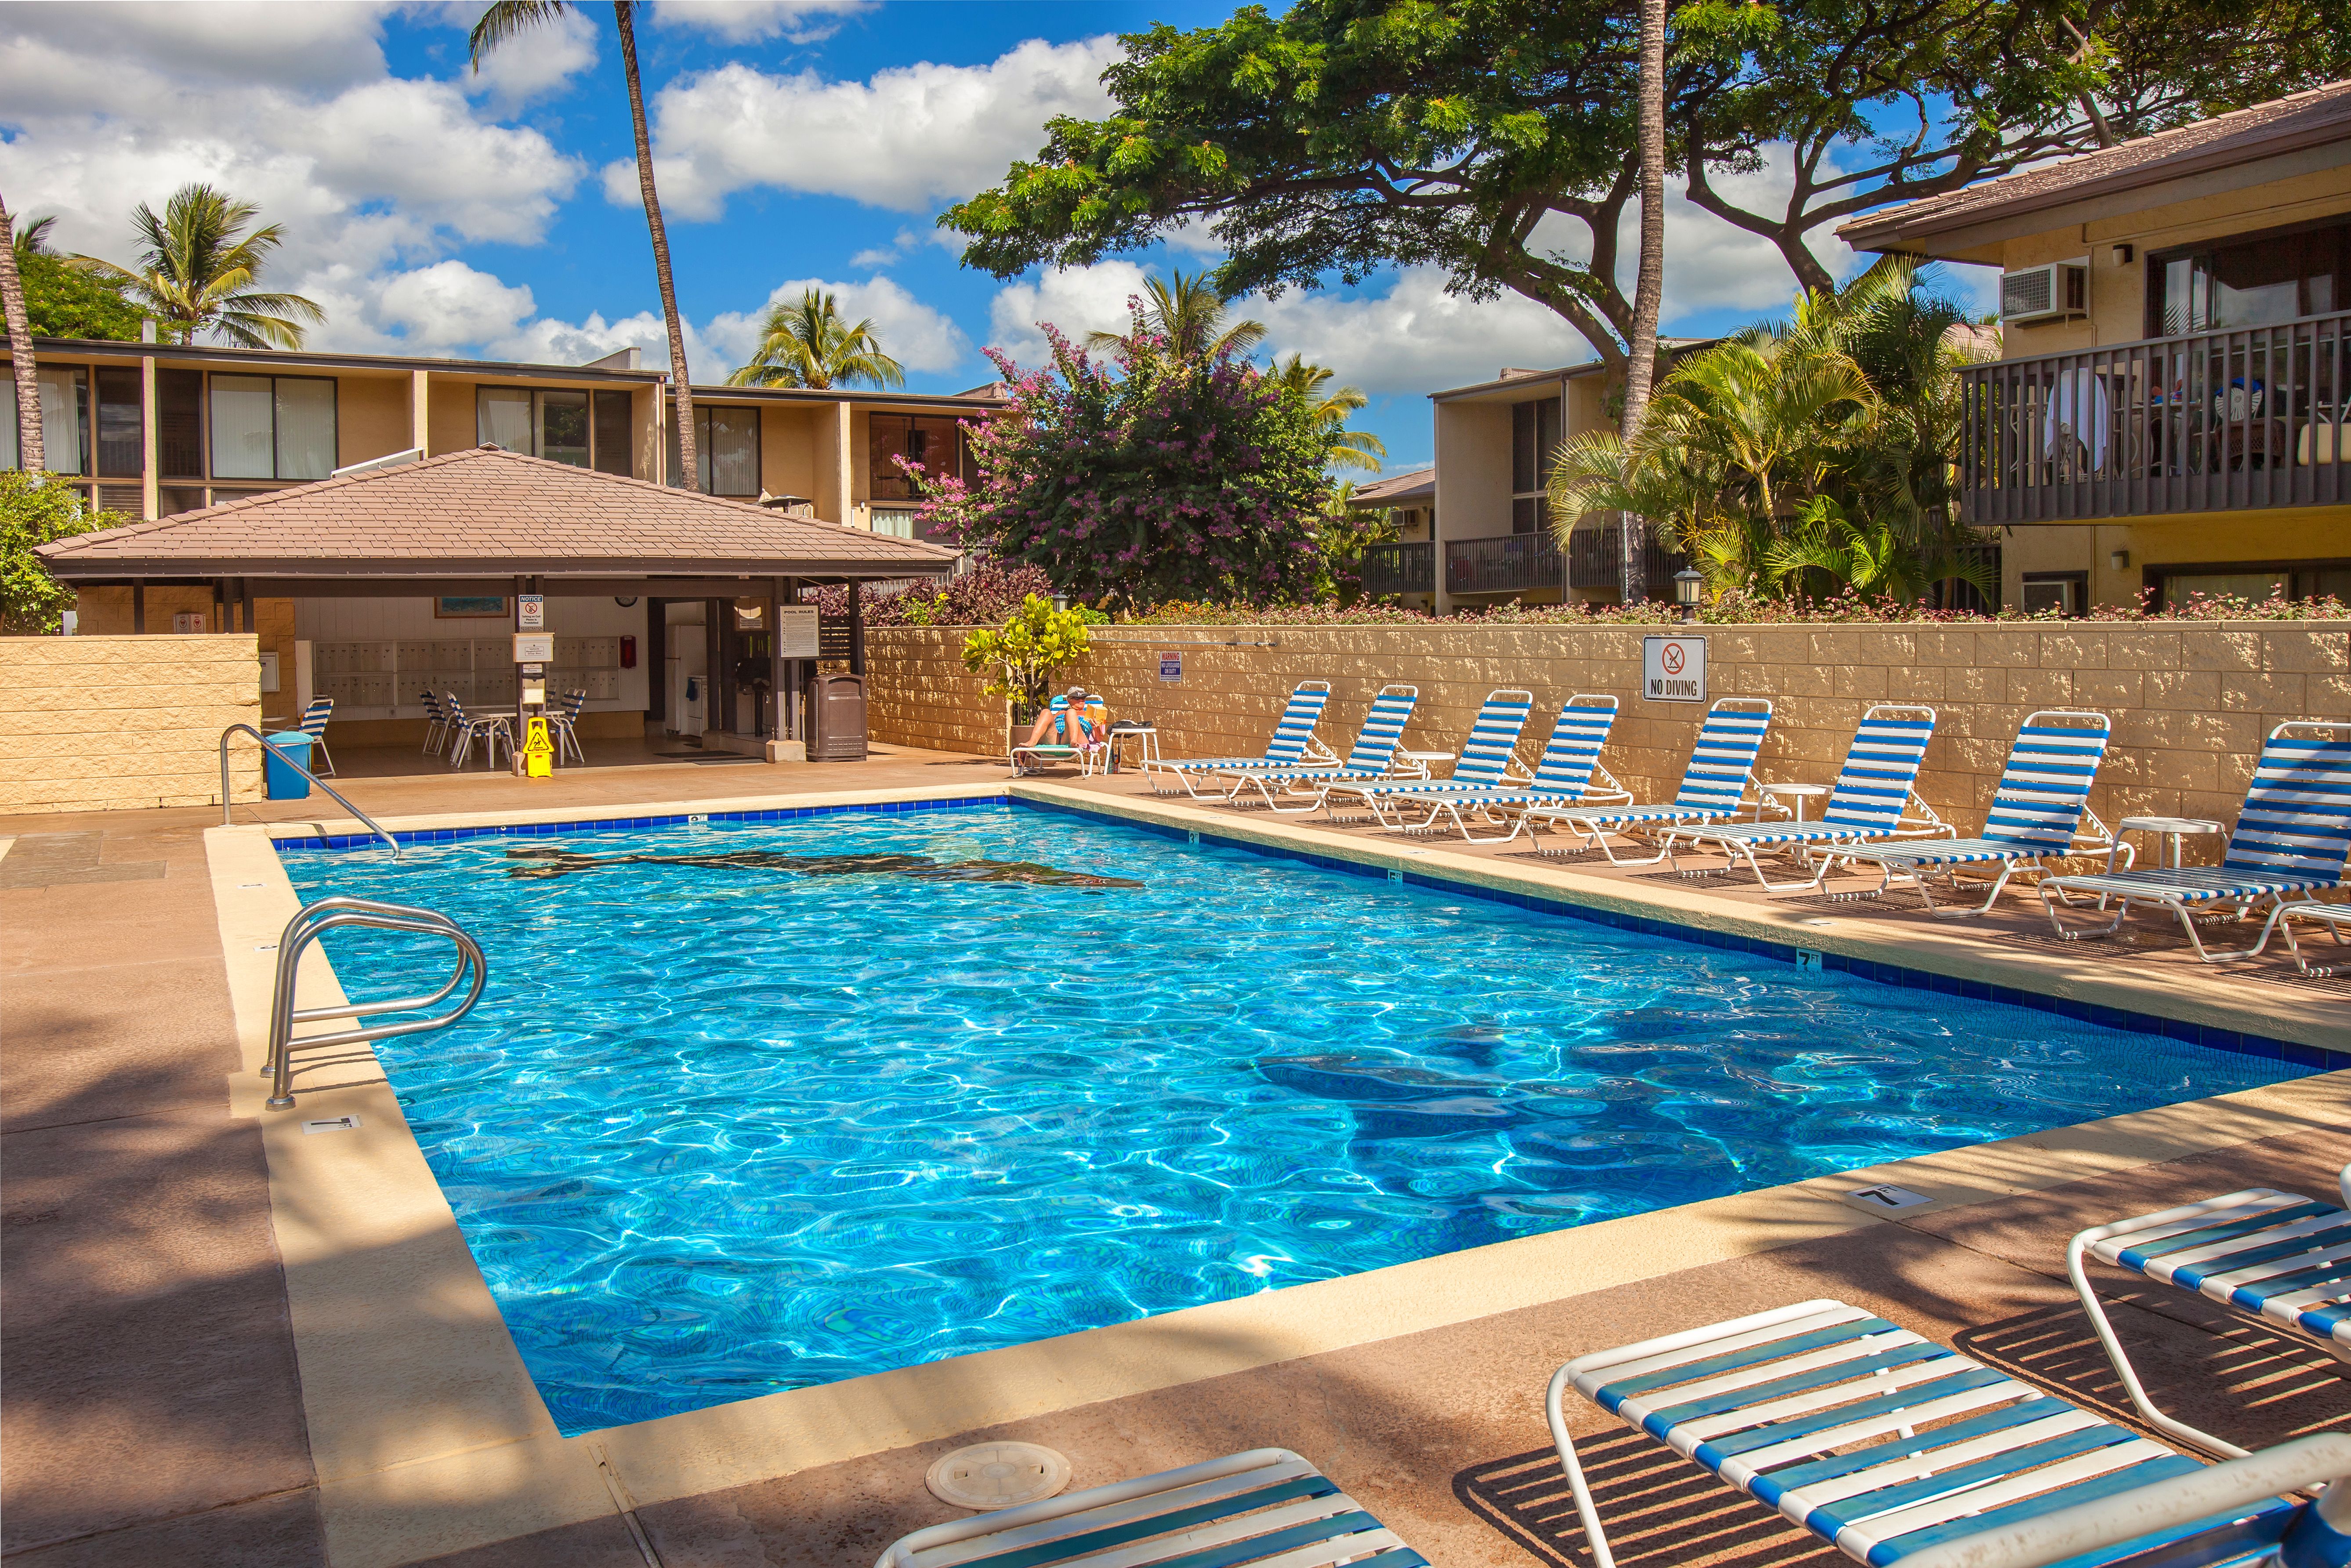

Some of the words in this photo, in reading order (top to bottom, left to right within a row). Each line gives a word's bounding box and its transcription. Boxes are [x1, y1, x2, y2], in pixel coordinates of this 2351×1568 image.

[1162, 652, 1180, 661] WARNING
[1651, 679, 1663, 695] NO
[1666, 679, 1697, 696] DIVING
[1799, 951, 1810, 966] 7
[1811, 954, 1819, 963] FT
[311, 1117, 351, 1126] 7
[1856, 1190, 1900, 1206] 7
